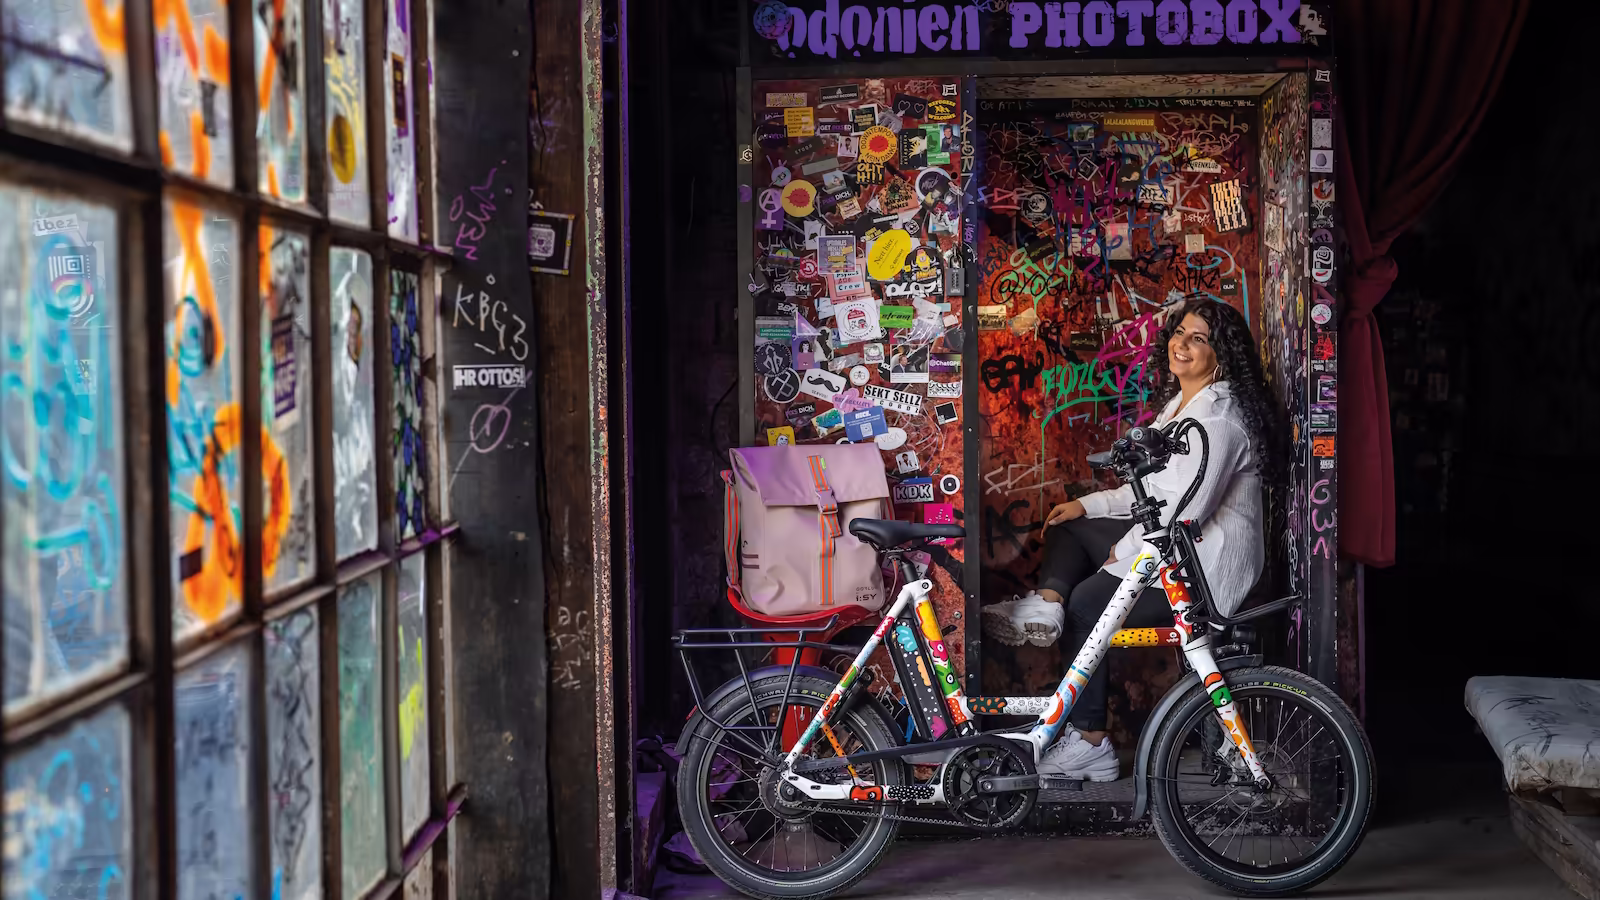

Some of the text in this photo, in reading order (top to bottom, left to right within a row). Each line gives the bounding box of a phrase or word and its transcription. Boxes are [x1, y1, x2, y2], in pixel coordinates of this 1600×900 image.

[1008, 0, 1301, 49] PHOTOBOX
[927, 99, 957, 107] REFUGEES
[820, 124, 832, 132] GET
[860, 126, 895, 150] DOWNTEMPO?
[865, 385, 921, 406] SEKT SELLZ
[895, 483, 931, 500] KDK
[1272, 681, 1307, 695] PICK-UP
